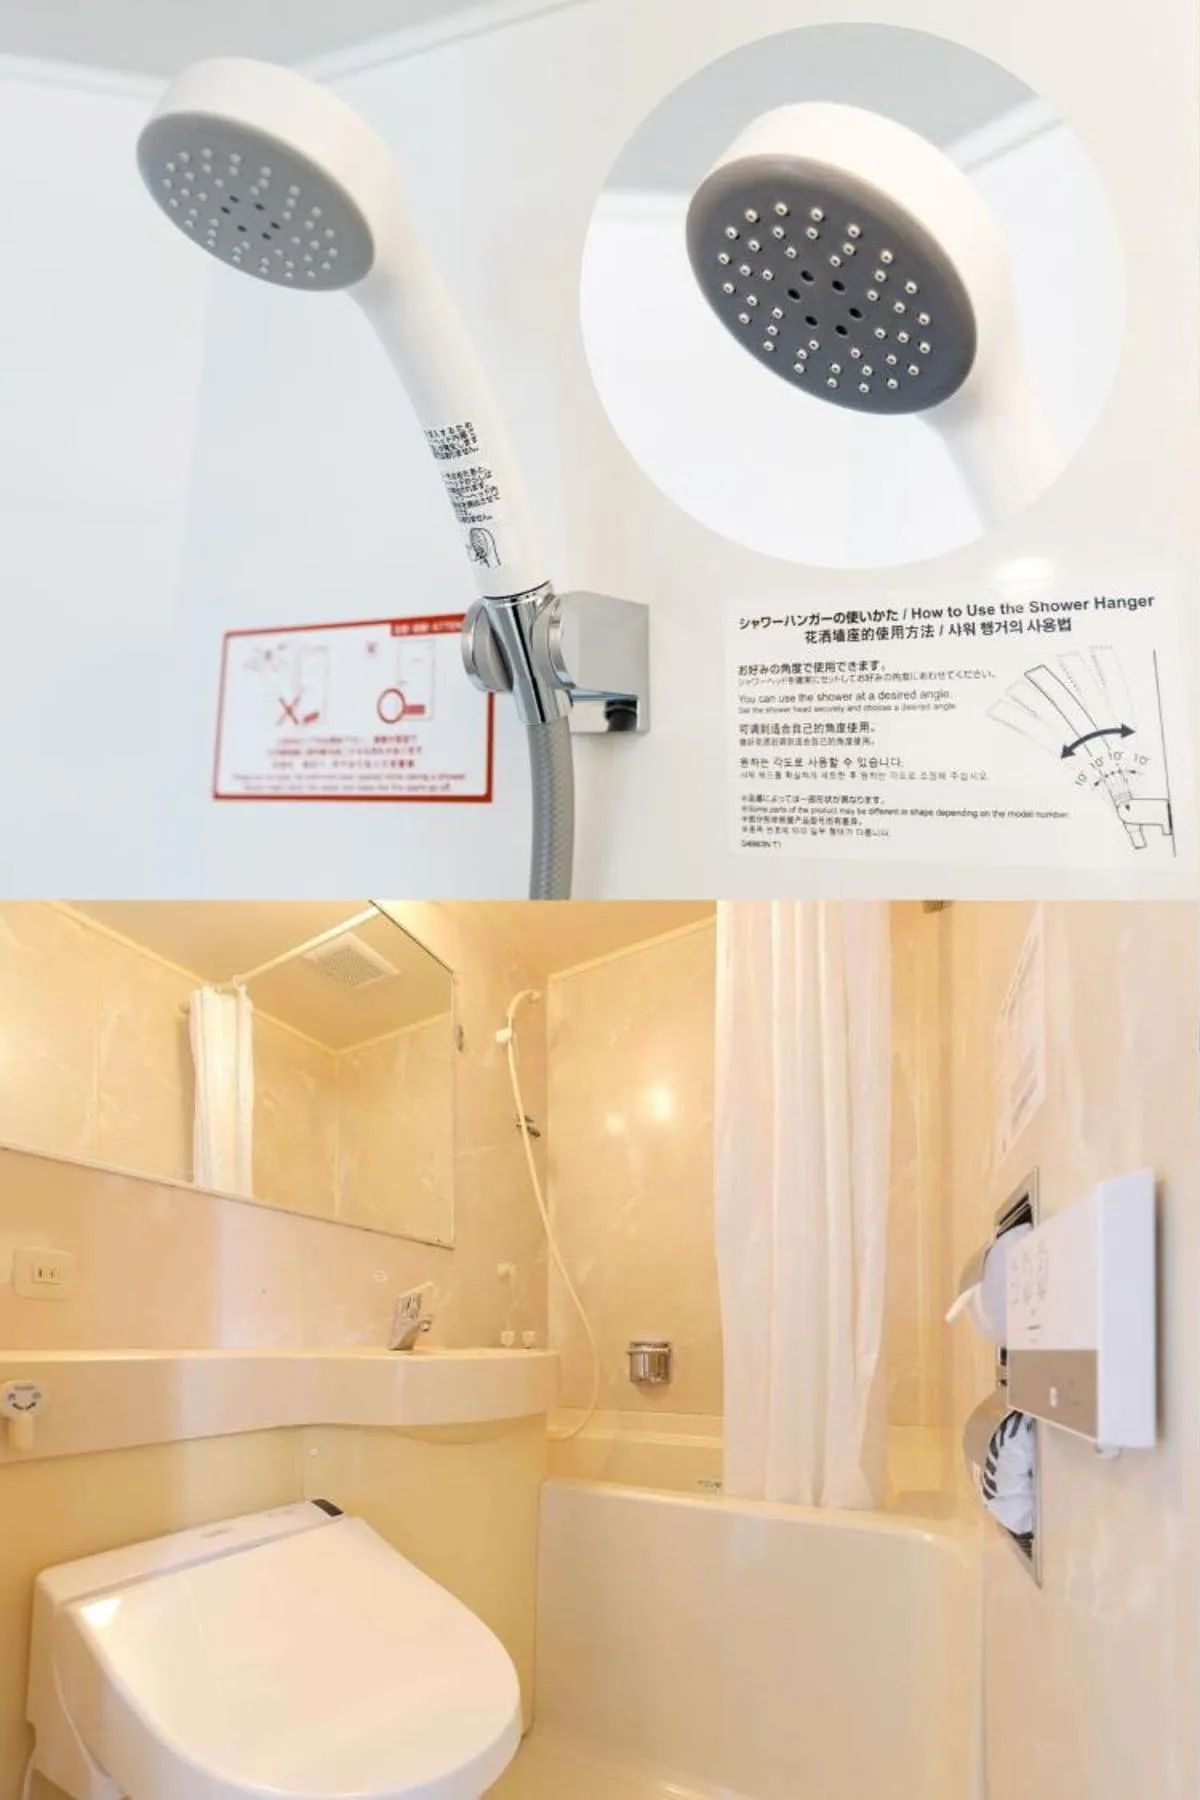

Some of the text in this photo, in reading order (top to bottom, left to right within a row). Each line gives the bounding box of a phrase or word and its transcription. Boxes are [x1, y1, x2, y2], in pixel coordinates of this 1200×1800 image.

[739, 608, 898, 630] シャワーハンガーの使いかた
[911, 606, 943, 619] How
[947, 606, 962, 618] to
[966, 604, 995, 617] Use
[1000, 603, 1024, 615] the
[1029, 599, 1089, 614] Shower
[1094, 596, 1155, 611] Hanger
[1027, 617, 1072, 633] 사용법
[816, 692, 852, 702] shower
